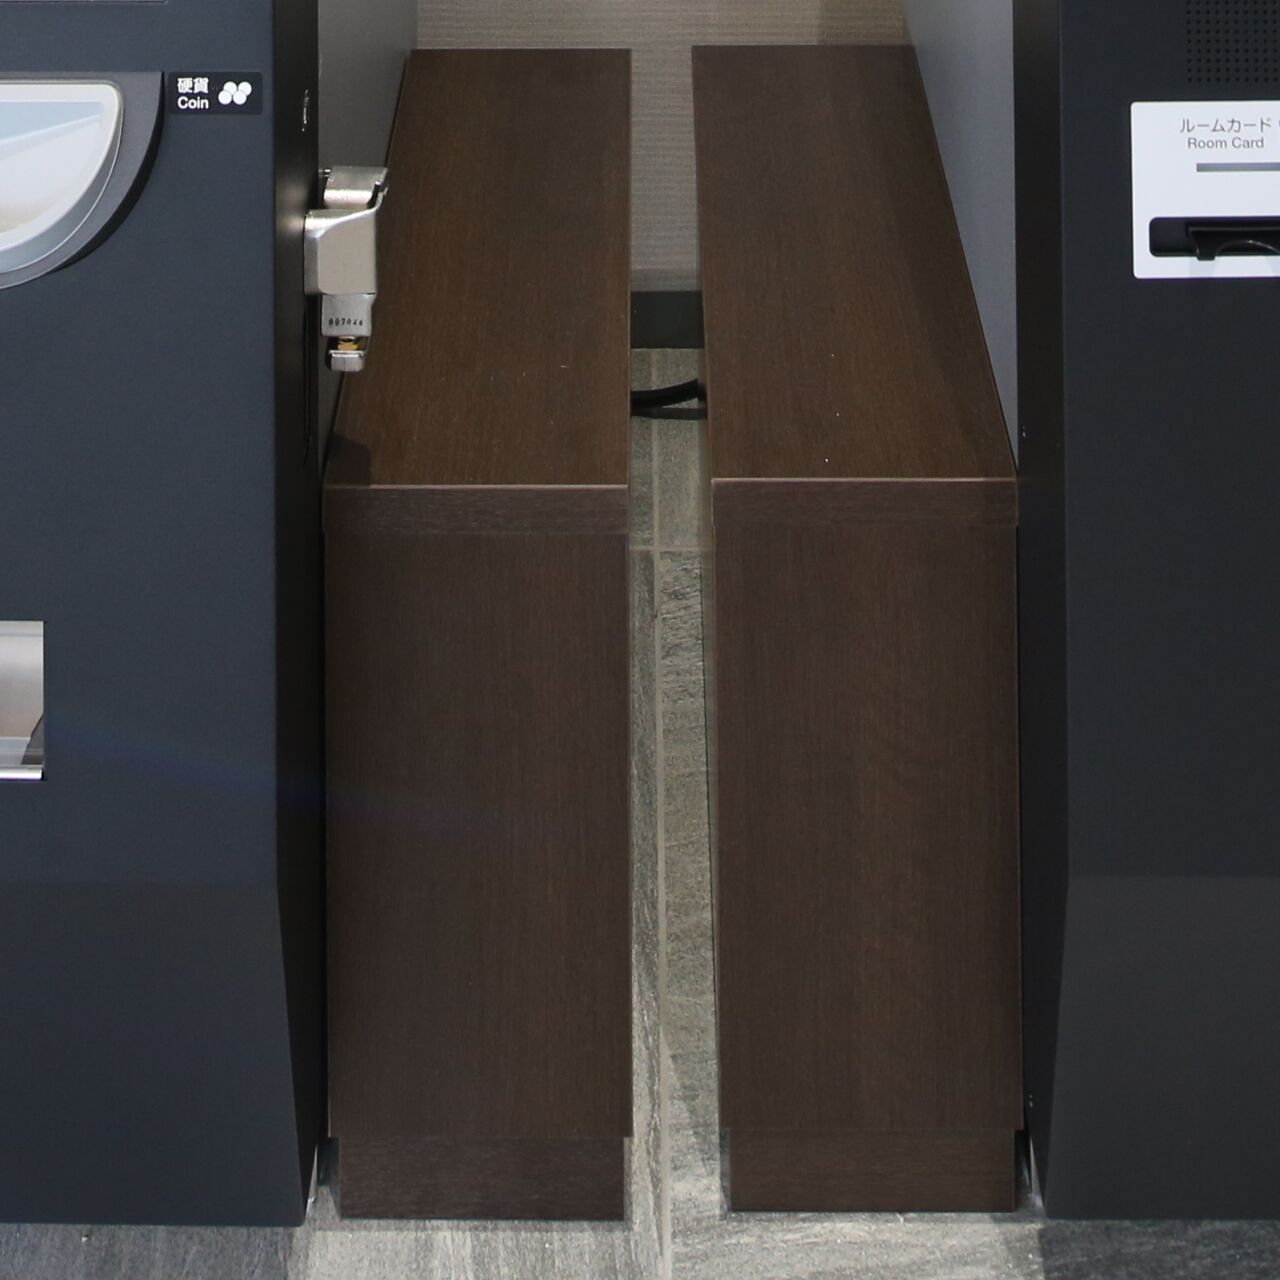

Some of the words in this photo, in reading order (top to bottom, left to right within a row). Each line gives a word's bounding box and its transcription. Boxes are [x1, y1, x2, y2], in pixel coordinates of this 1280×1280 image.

[177, 77, 209, 94] 硬貨
[177, 97, 209, 109] Coin
[1179, 118, 1272, 134] ルームカード
[1187, 137, 1227, 149] Room
[1231, 137, 1264, 149] Card
